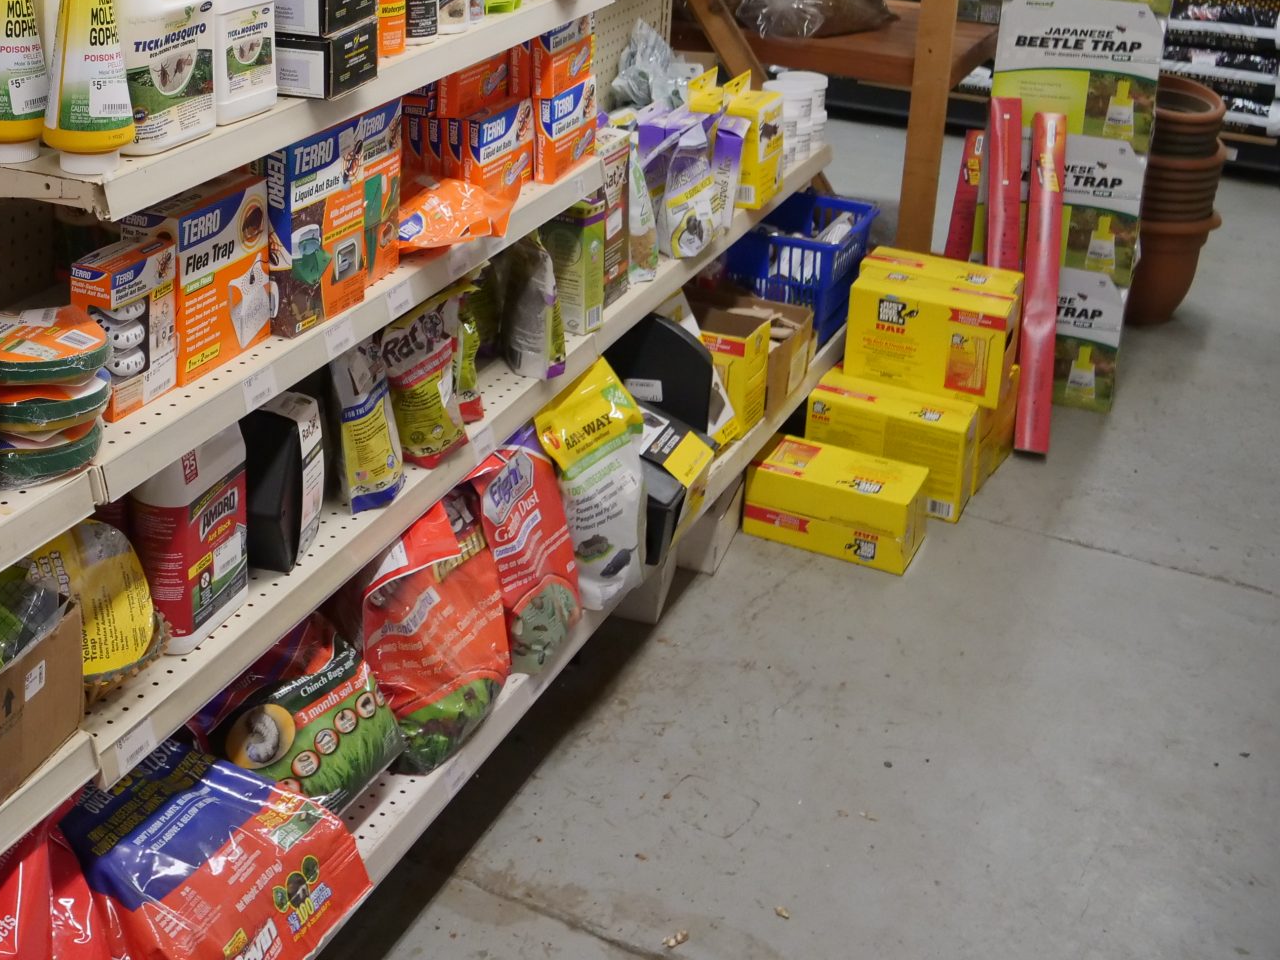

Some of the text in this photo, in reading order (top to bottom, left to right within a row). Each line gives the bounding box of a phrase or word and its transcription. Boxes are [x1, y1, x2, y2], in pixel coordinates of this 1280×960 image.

[1015, 36, 1142, 53] BEETLE TRAP
[1045, 27, 1114, 39] JAPANESE
[0, 45, 29, 53] POISON
[84, 54, 114, 62] POISON
[554, 94, 574, 118] TERRO
[483, 117, 506, 144] TERRO
[294, 138, 334, 175] TERRO
[483, 147, 496, 160] Liquid
[503, 141, 512, 150] Baits
[294, 176, 340, 202] Liquid Ant Baits
[183, 208, 221, 245] TERRO
[186, 239, 235, 275] Flea Trap
[183, 456, 196, 471] 25
[202, 491, 236, 536] AMDRO
[518, 490, 540, 516] Dust
[300, 683, 353, 723] 3 month soil
